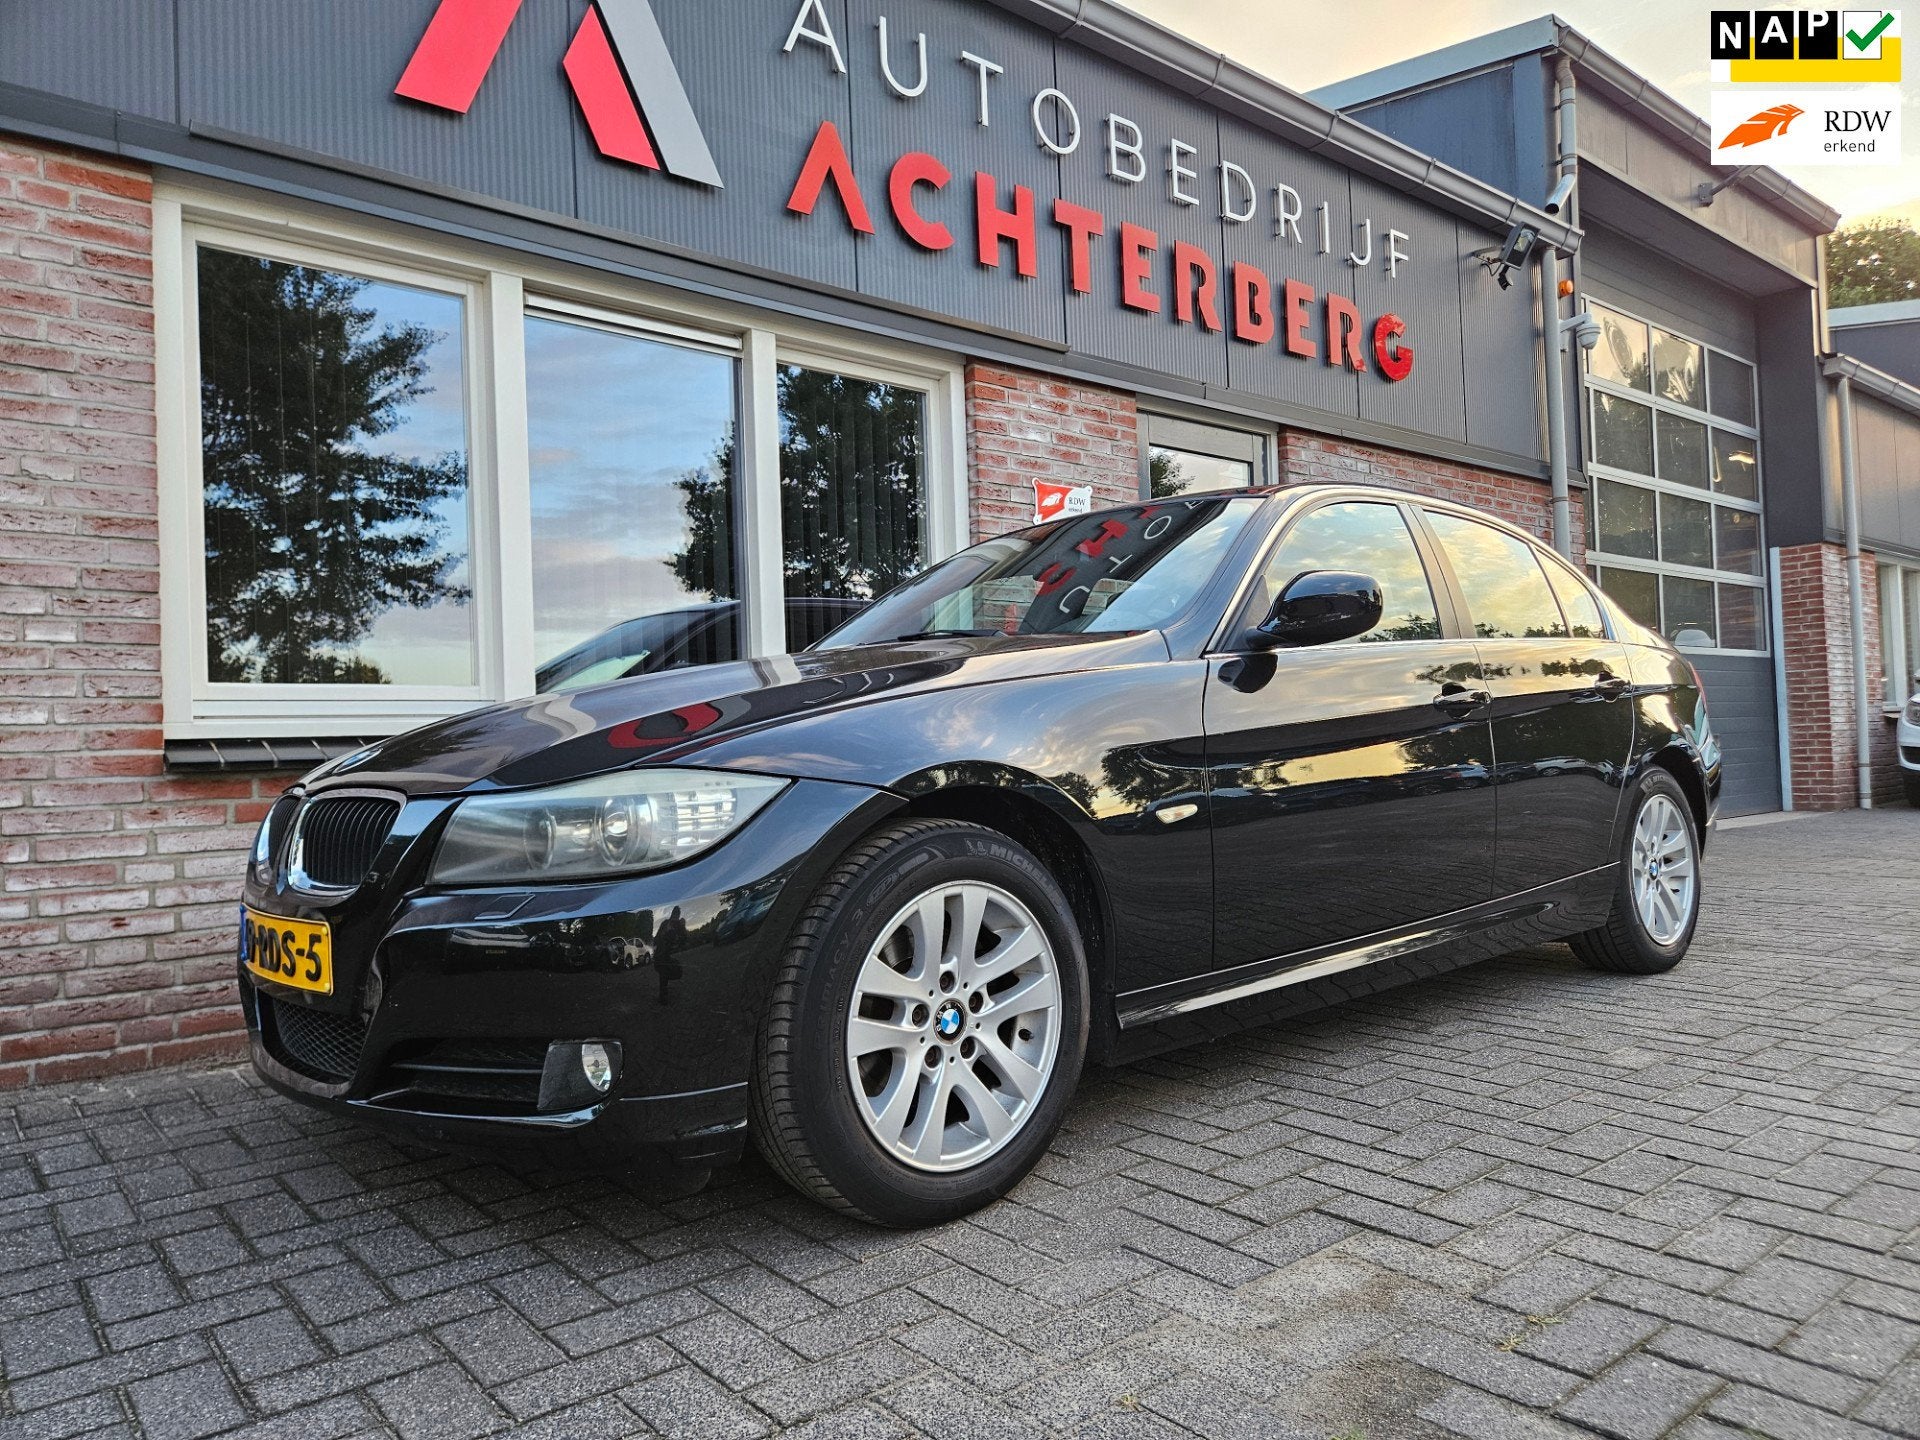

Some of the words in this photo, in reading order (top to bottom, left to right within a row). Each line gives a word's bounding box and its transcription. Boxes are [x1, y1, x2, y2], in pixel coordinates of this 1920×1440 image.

[783, 0, 1410, 278] AUTOBEDRIJF
[786, 121, 1414, 381] ACHTERBERG
[1068, 496, 1086, 506] RDW
